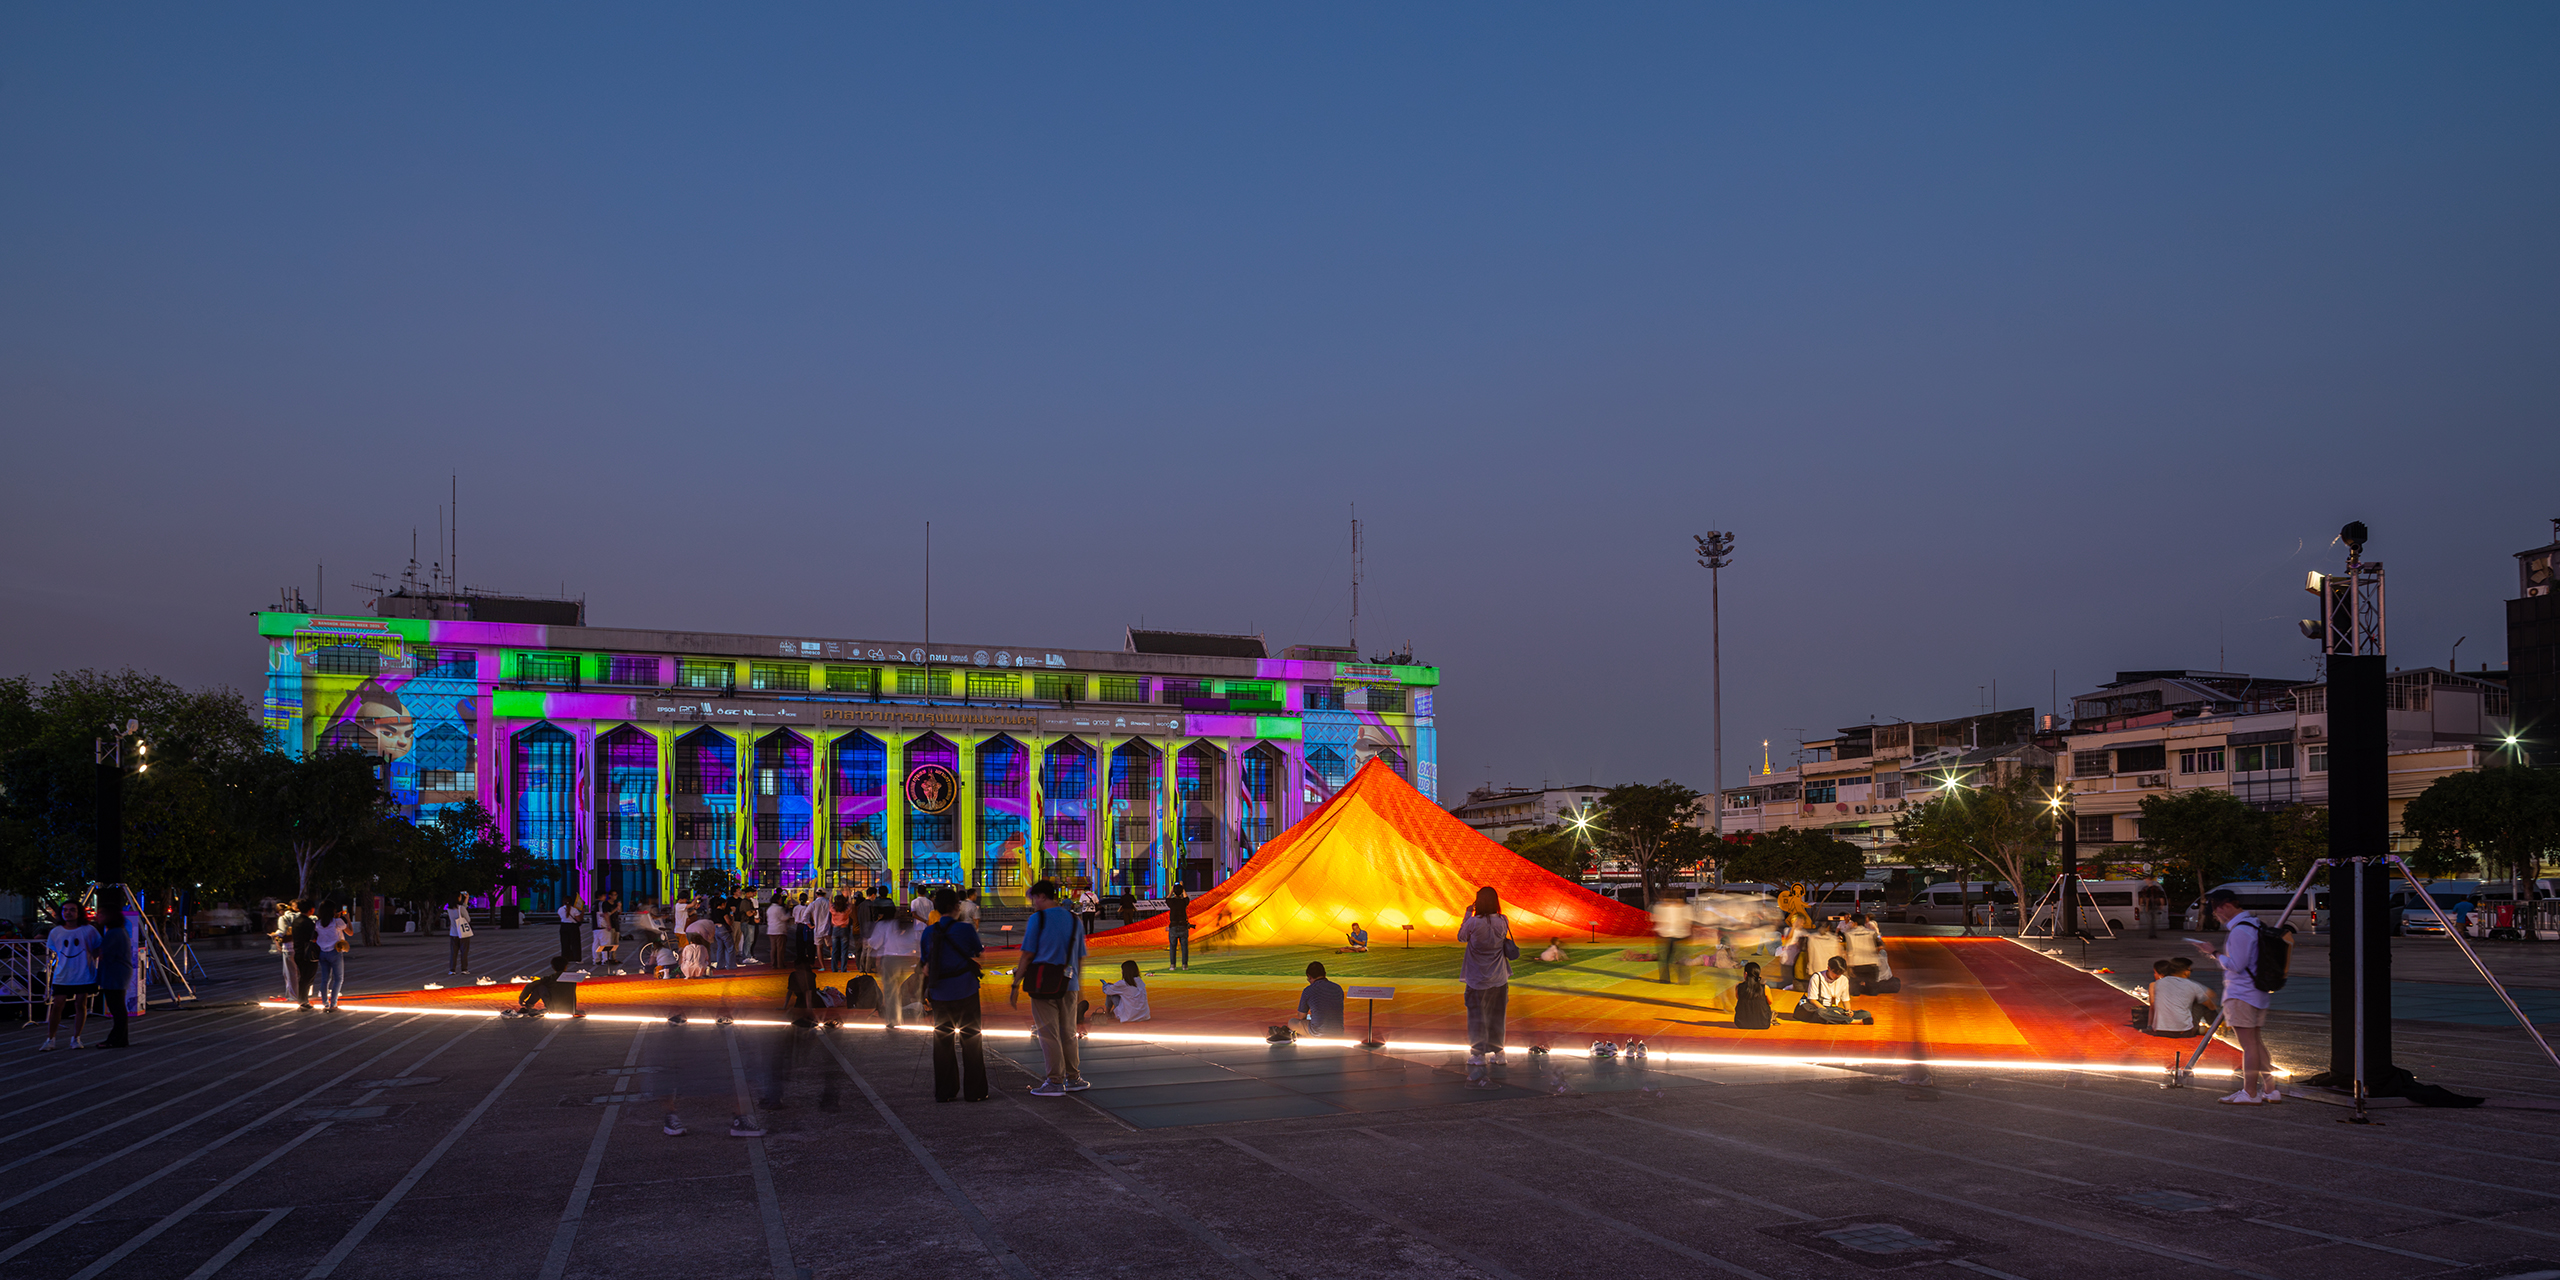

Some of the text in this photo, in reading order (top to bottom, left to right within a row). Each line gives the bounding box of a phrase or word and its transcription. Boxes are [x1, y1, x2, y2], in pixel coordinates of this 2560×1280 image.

[296, 631, 339, 655] DESIGN
[822, 708, 1037, 726] ศาลาว่าการกรุงเทพมหานคร
[460, 923, 470, 932] 15
